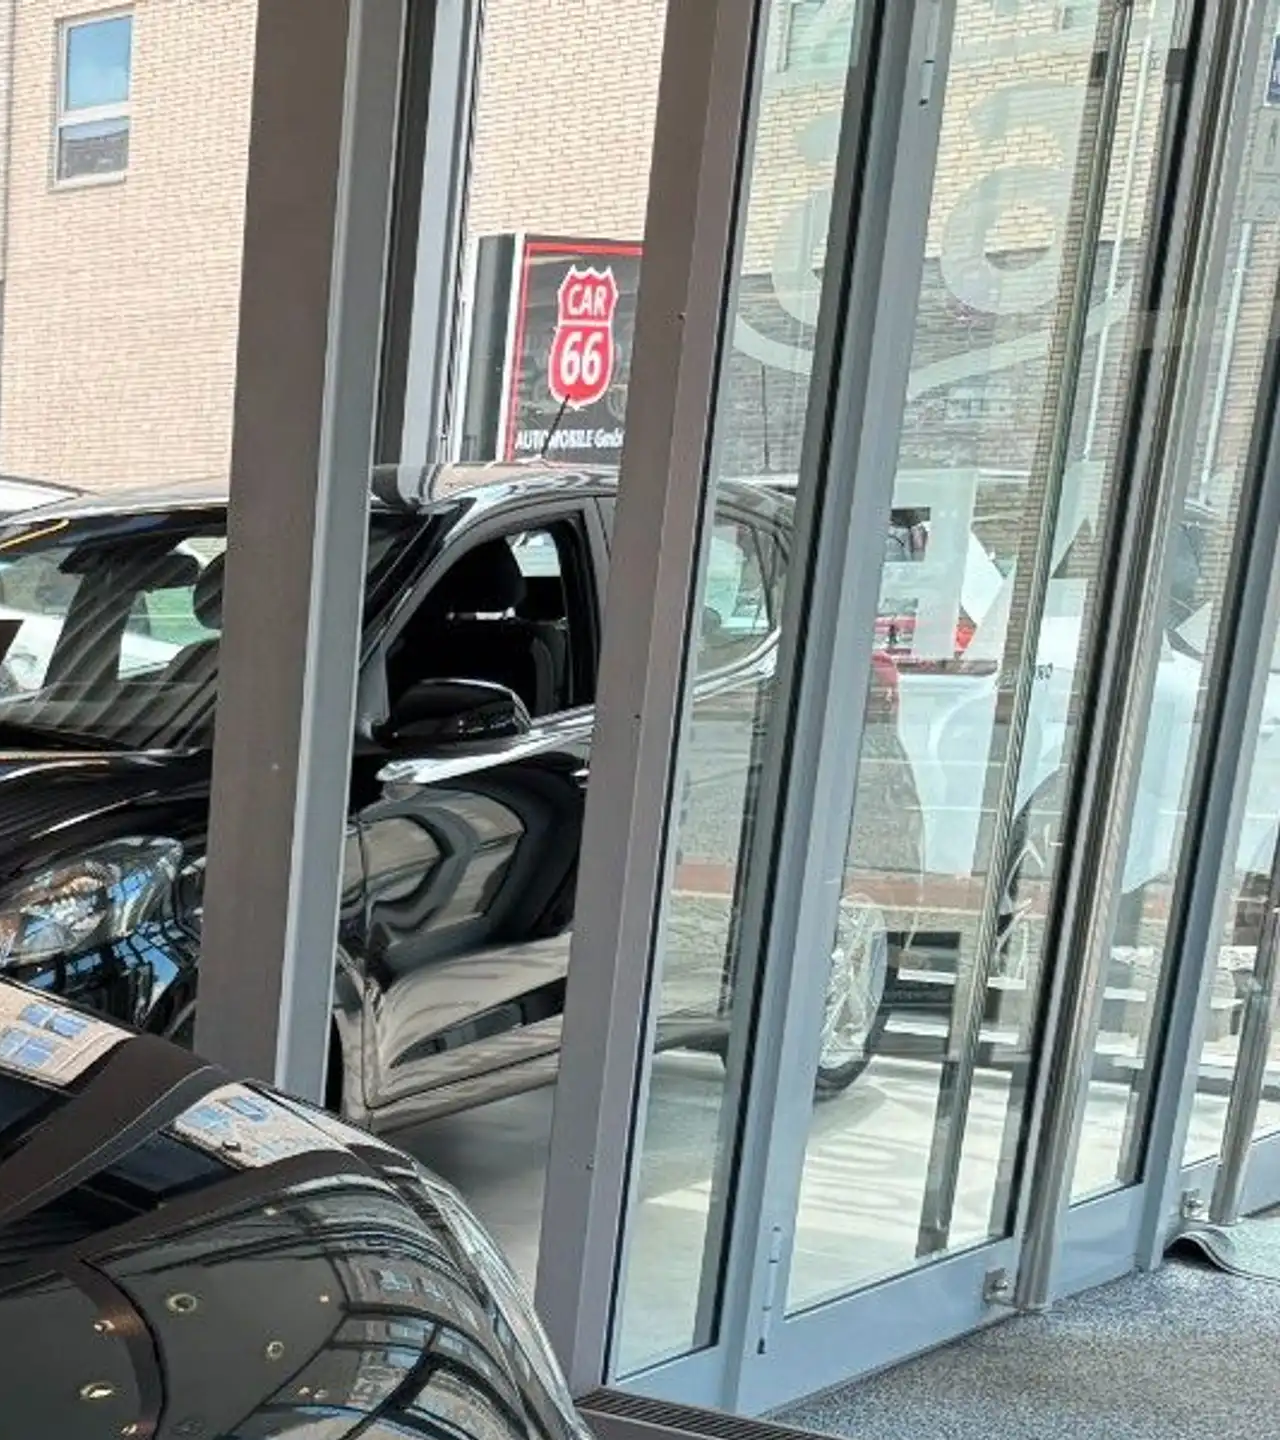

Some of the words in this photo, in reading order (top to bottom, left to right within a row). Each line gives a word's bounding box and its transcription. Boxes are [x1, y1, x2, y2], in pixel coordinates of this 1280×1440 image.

[567, 284, 607, 316] CAR
[559, 331, 604, 386] 66
[514, 428, 594, 450] AUTOMOBILE
[595, 427, 625, 449] Gmb
